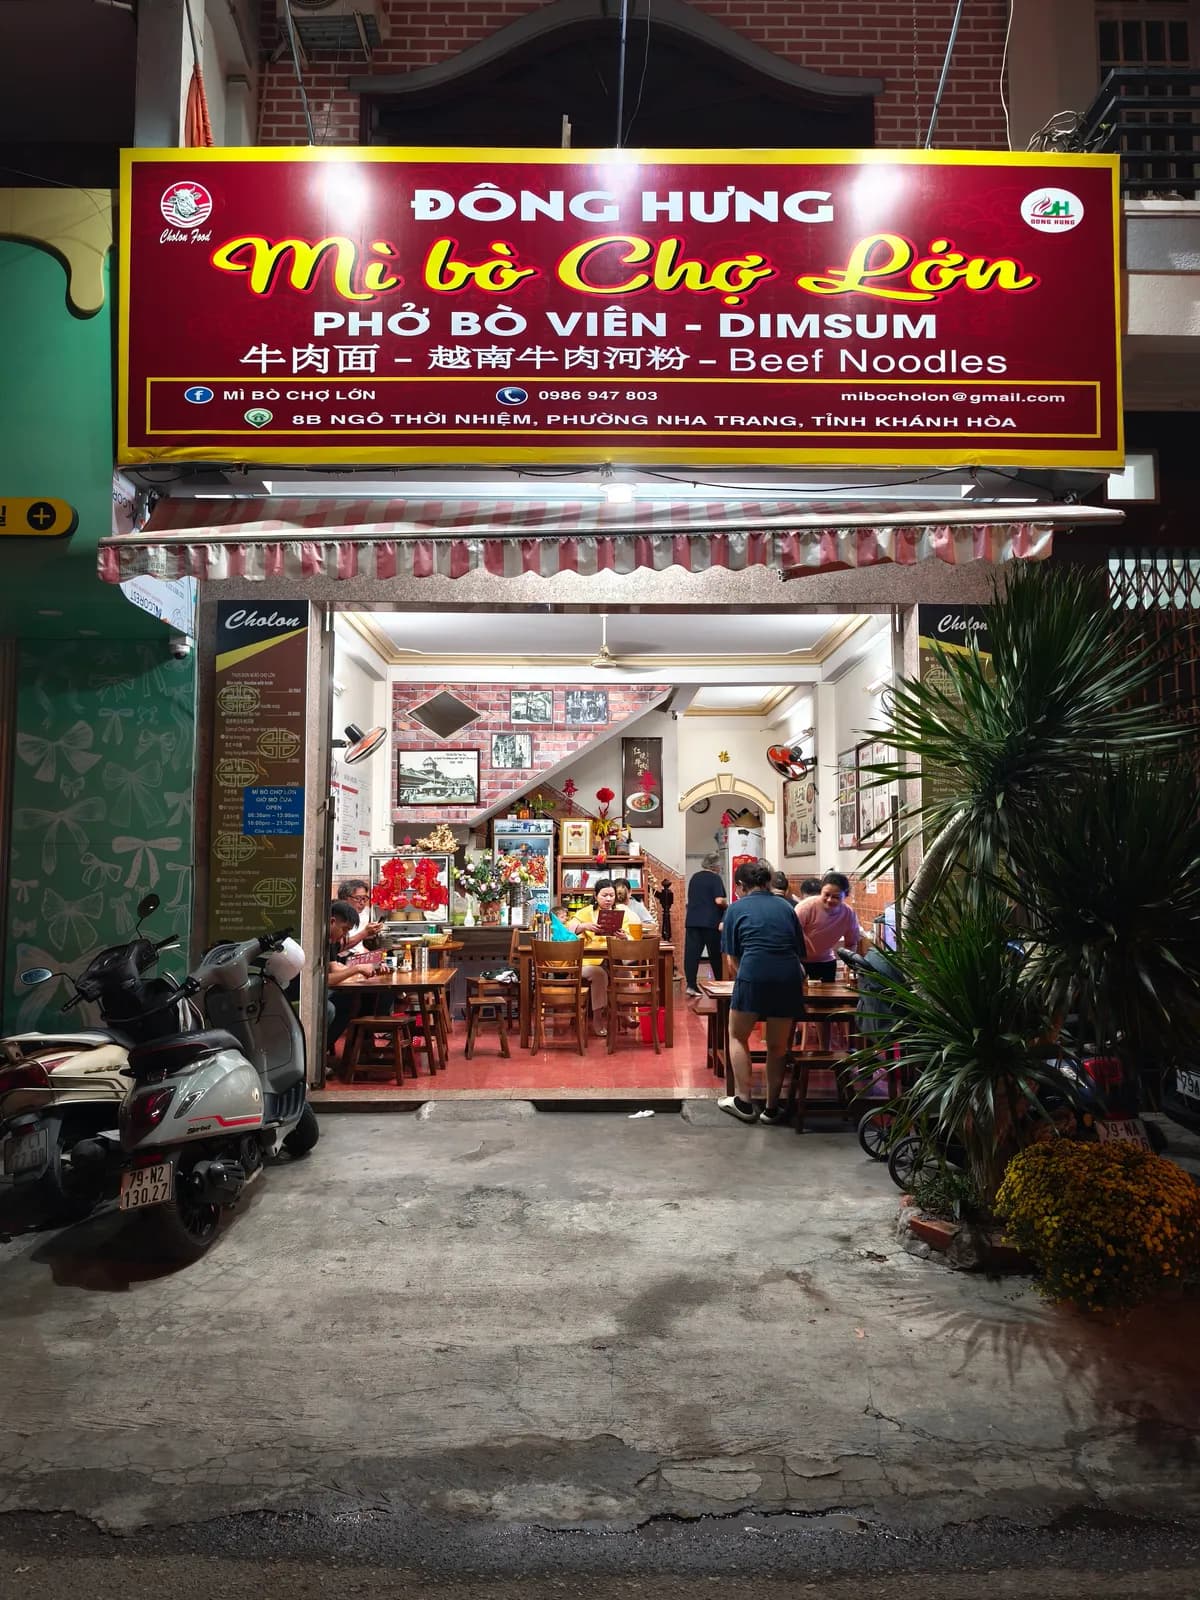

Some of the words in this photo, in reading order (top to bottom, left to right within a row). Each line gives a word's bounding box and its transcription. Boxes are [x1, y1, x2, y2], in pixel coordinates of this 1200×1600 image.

[410, 183, 619, 222] ĐÔNG
[641, 186, 834, 223] HƯNG
[159, 228, 188, 244] Cholon
[190, 228, 212, 245] Food
[212, 236, 400, 301] Mì
[425, 238, 537, 293] bò
[557, 235, 774, 307] Chợ
[797, 232, 1035, 302] Lớn
[313, 303, 430, 337] PHỞ
[451, 304, 528, 337] BÒ
[545, 305, 667, 337] VIÊN
[719, 314, 937, 339] DIMSUM
[239, 343, 381, 375] 牛肉面
[427, 344, 691, 371] 越南牛肉河粉
[730, 348, 824, 373] Beef
[839, 348, 1007, 374] Noodles
[223, 389, 245, 401] MÌ
[251, 388, 281, 401] BÒ
[286, 390, 330, 402] CHỢ
[335, 388, 376, 401] LỚN
[538, 390, 582, 401] 0986
[587, 391, 620, 401] 947
[625, 391, 658, 401] 803
[841, 391, 1065, 404] mibocholon@gmail.com
[292, 414, 322, 425] 8B
[330, 412, 384, 425] NGÔ
[390, 412, 447, 425] THỜI
[455, 412, 538, 426] NHIỆM,
[546, 413, 649, 426] PHƯỜNG
[657, 415, 707, 426] NHA
[713, 415, 804, 428] TRANG,
[811, 413, 866, 427] TỈNH
[875, 415, 958, 428] KHÁNH
[967, 415, 1017, 428] HÒA
[224, 609, 301, 630] Cholon
[937, 614, 988, 633] Cholon
[129, 1166, 164, 1189] 79-N2
[125, 1182, 168, 1208] 130.27
